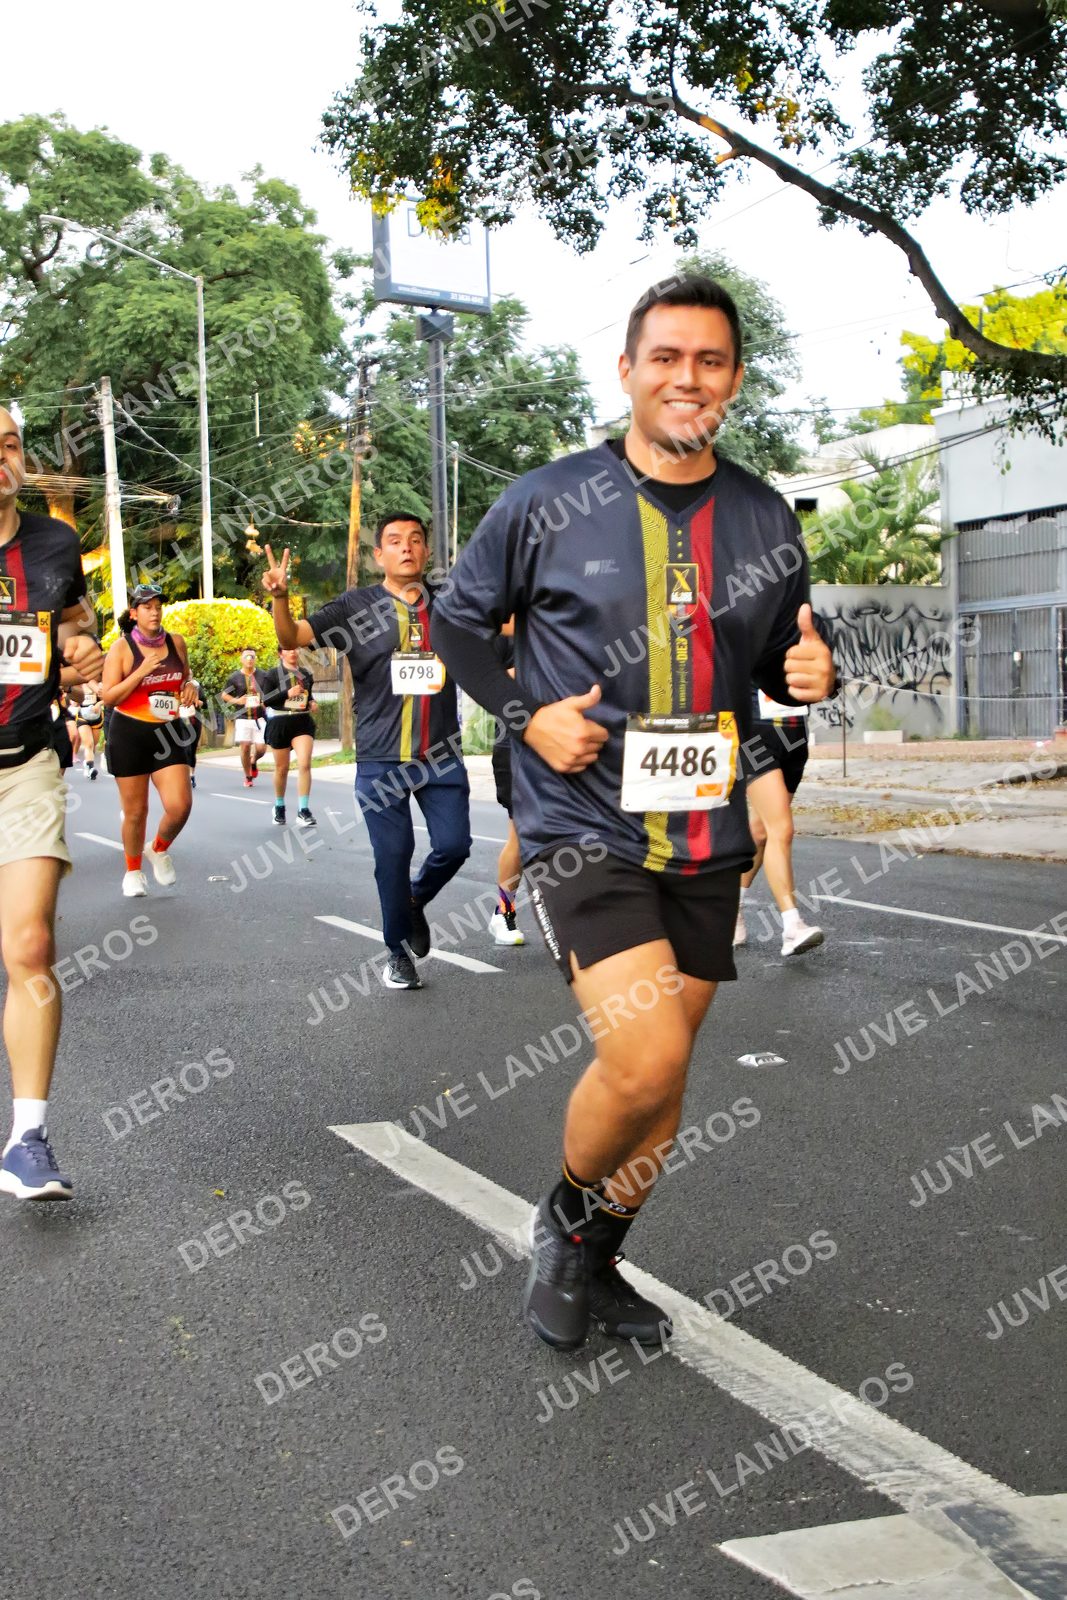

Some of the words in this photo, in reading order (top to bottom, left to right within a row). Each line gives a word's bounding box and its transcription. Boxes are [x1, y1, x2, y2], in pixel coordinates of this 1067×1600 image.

[399, 666, 434, 680] 6798
[154, 698, 174, 709] 2061
[640, 745, 717, 776] 4486
